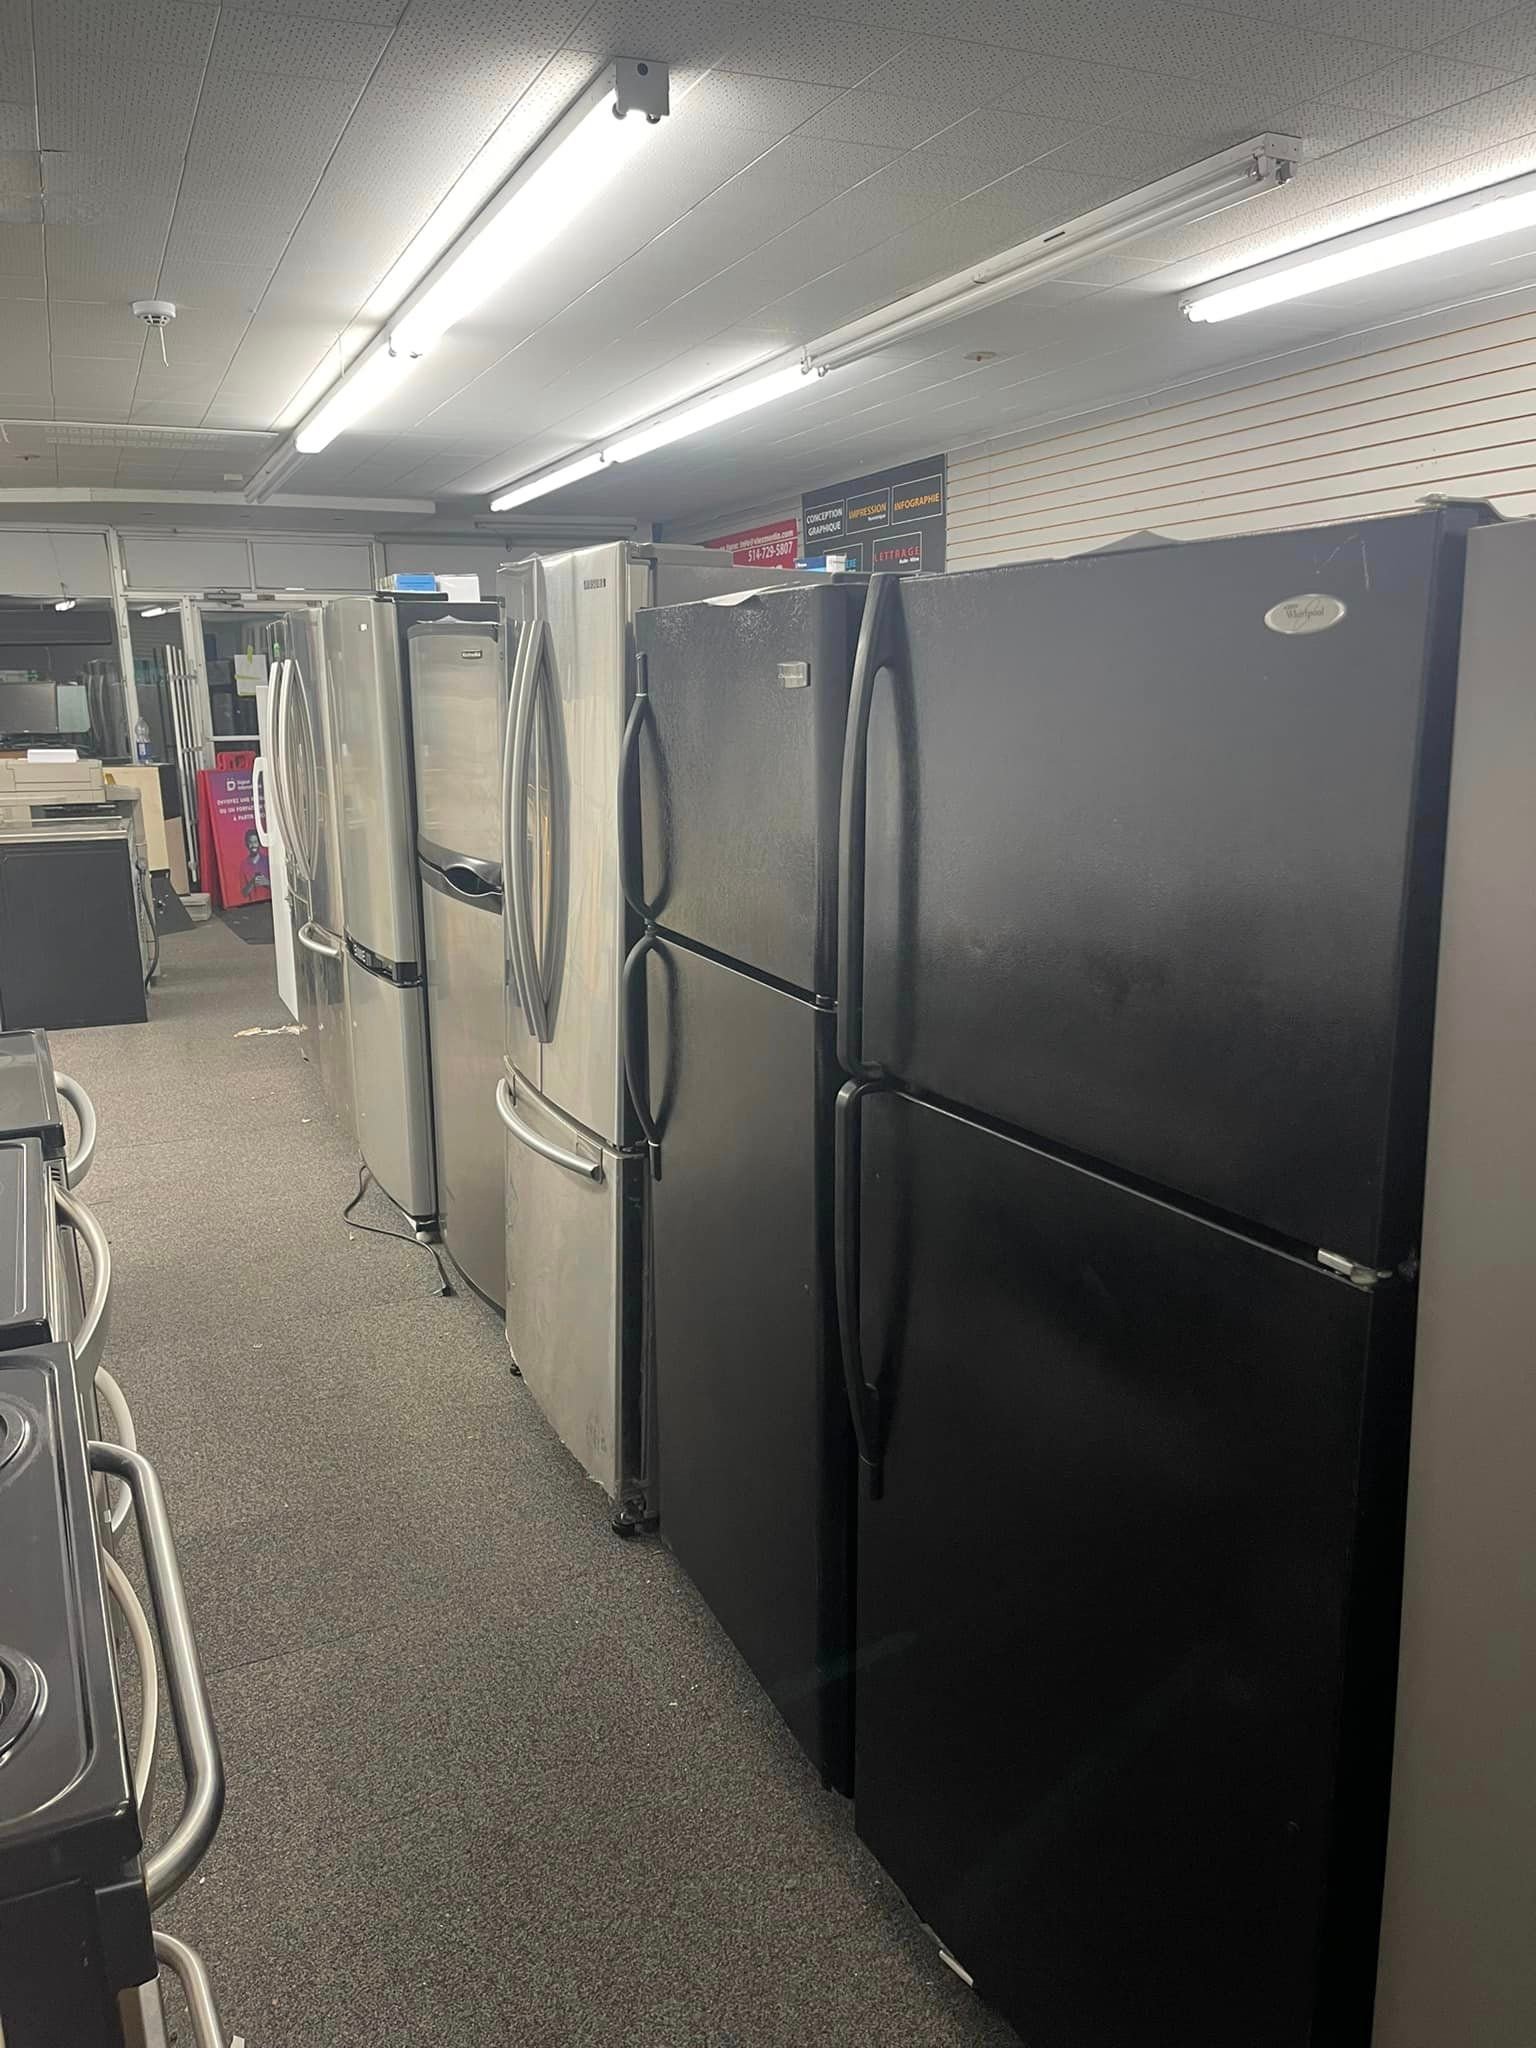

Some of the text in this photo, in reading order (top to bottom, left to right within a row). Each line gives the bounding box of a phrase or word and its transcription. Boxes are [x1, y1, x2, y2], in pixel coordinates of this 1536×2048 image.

[894, 492, 940, 511] INFOGRAPHIE
[806, 508, 843, 524] CONCEPTION
[848, 502, 887, 519] IMPRESSION
[808, 521, 841, 536] GRAPHIQUE
[748, 541, 793, 562] 514-729-5807
[874, 545, 921, 562] LETTRAGE
